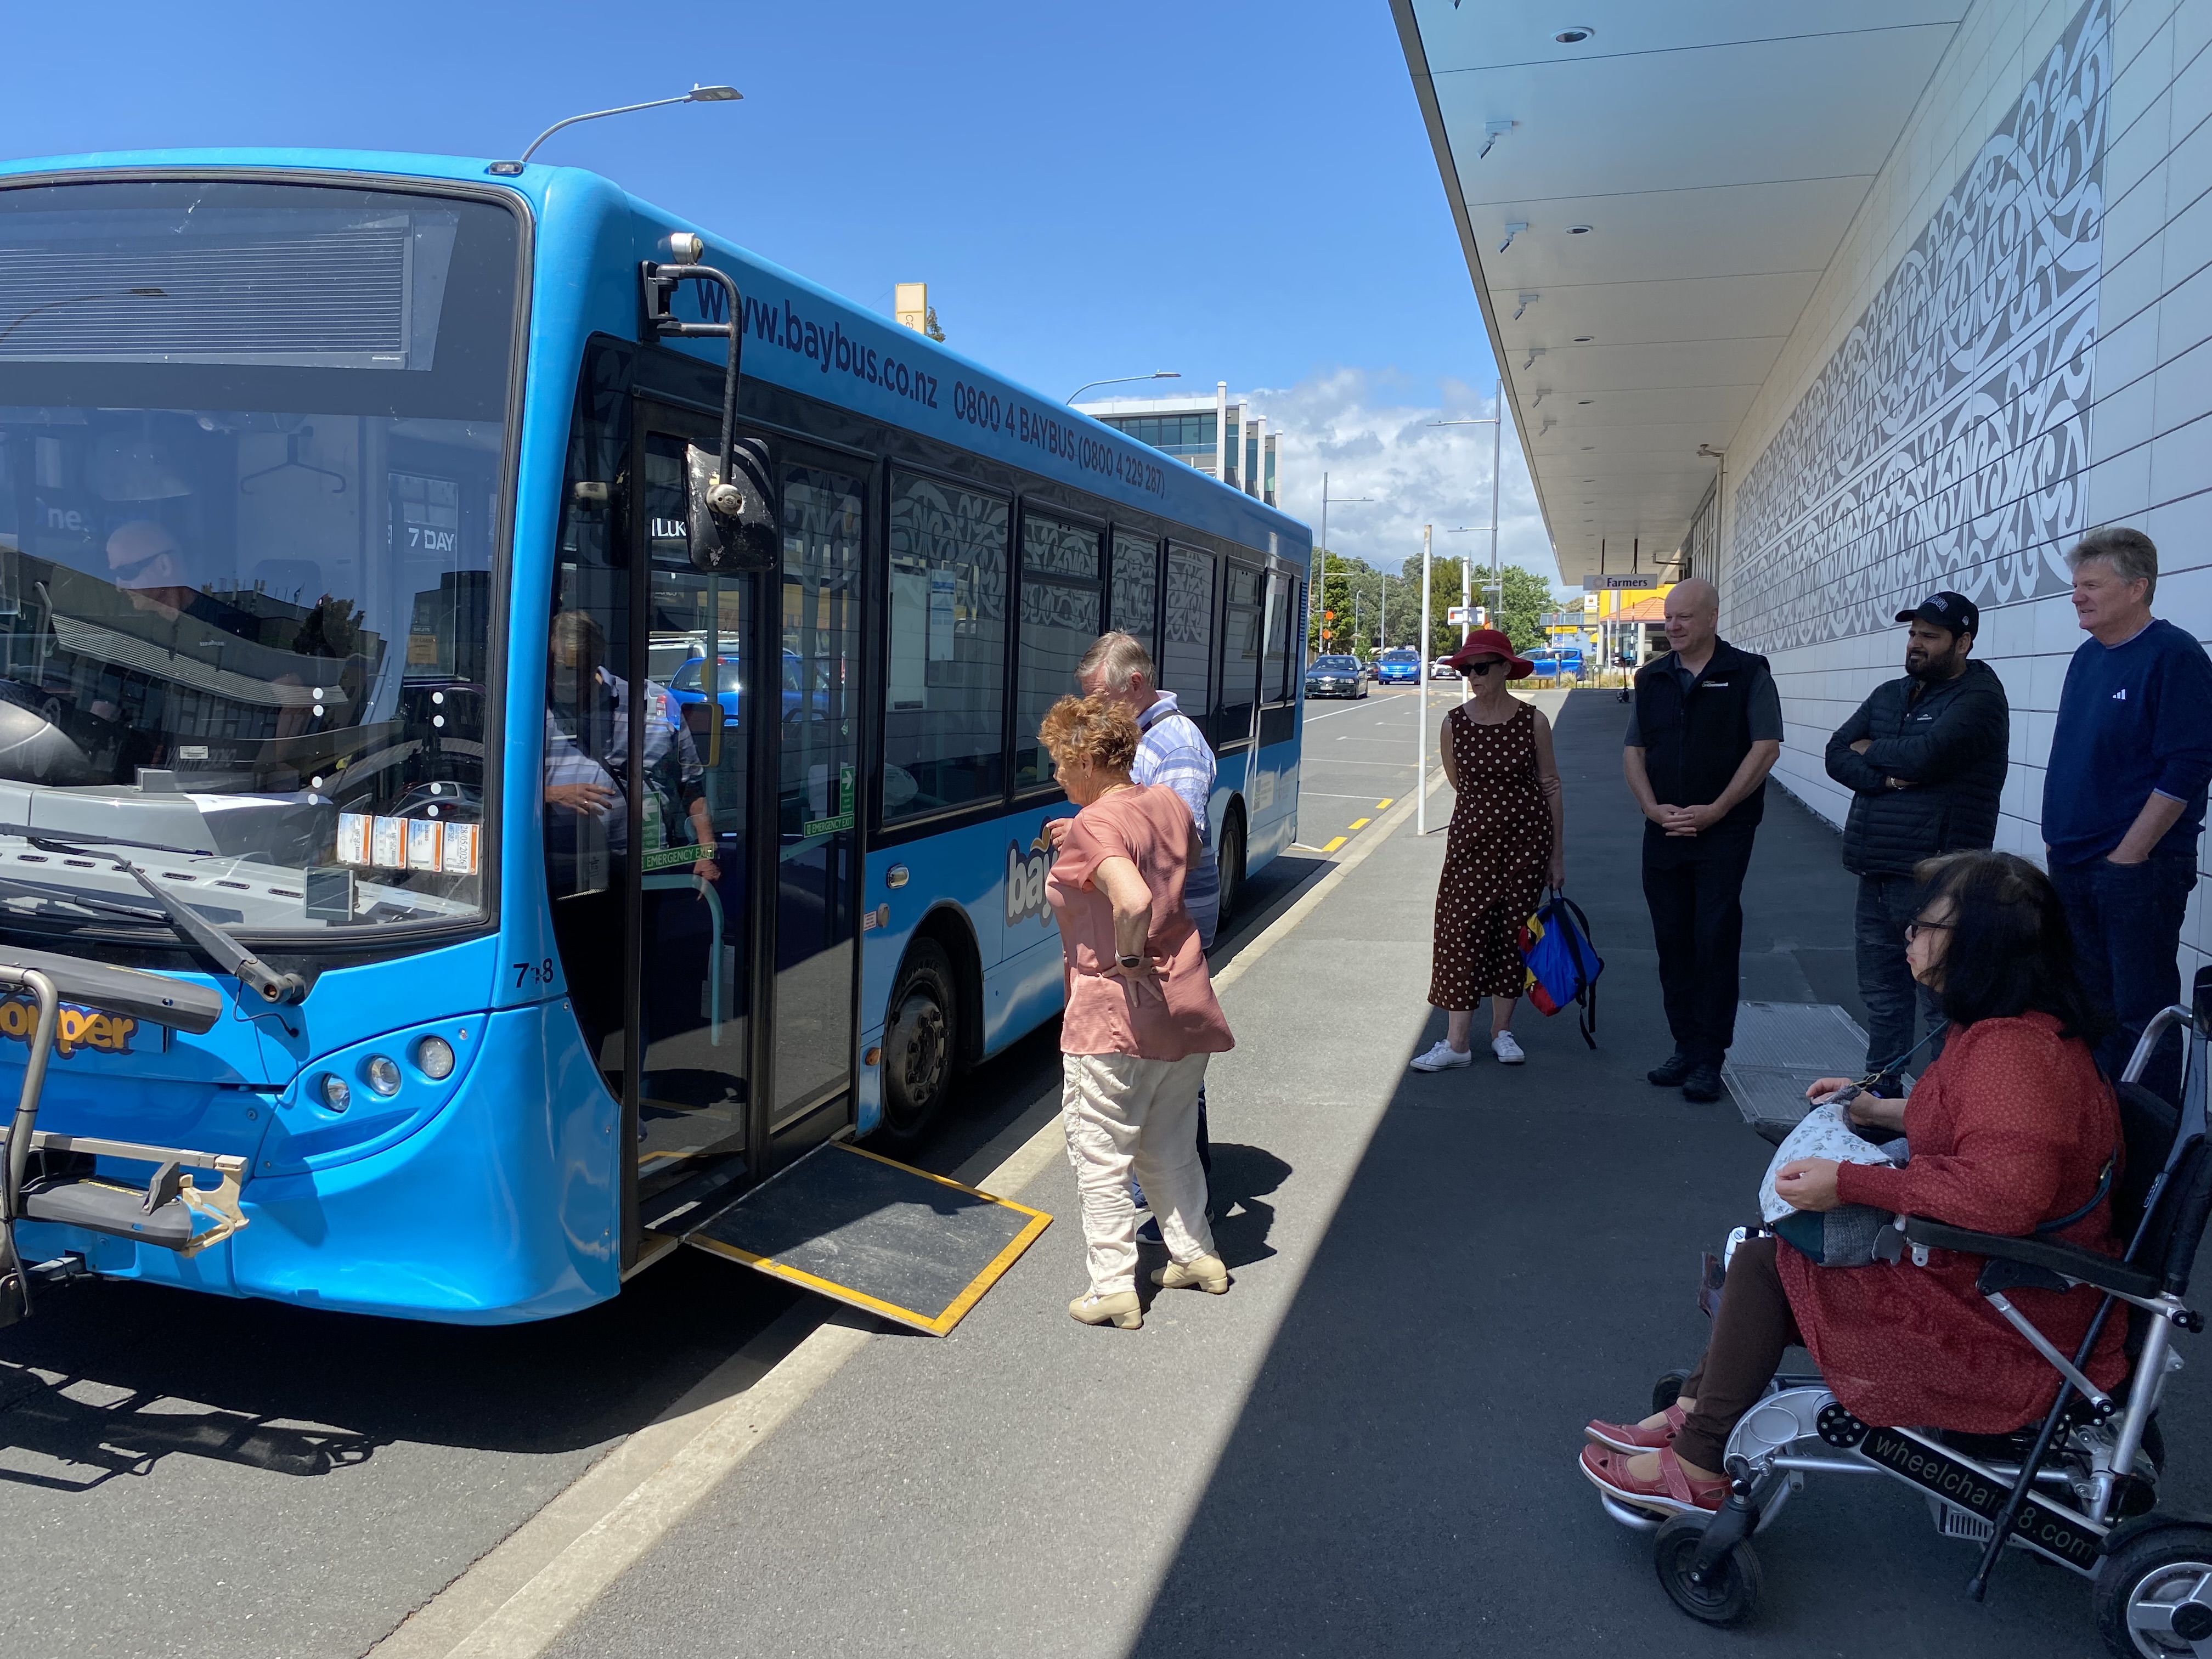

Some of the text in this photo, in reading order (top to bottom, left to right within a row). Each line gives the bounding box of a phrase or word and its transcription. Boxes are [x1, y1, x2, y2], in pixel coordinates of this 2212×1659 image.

[954, 381, 1000, 432] 0800
[1005, 402, 1015, 438] 4
[1019, 406, 1075, 461] BAYBUS
[1078, 435, 1114, 477] (0800
[1116, 452, 1124, 481] 4
[1125, 455, 1143, 488] 229
[1145, 464, 1165, 500] 287)
[408, 527, 420, 548] 7
[424, 529, 455, 552] DAY
[1607, 578, 1647, 587] Farmers
[812, 817, 853, 833] EMERGENCY EXIT
[459, 825, 468, 864] 28/05/2026
[647, 845, 712, 867] EMERGENCY EXIT
[1876, 1435, 2094, 1561] wheelchair8.com
